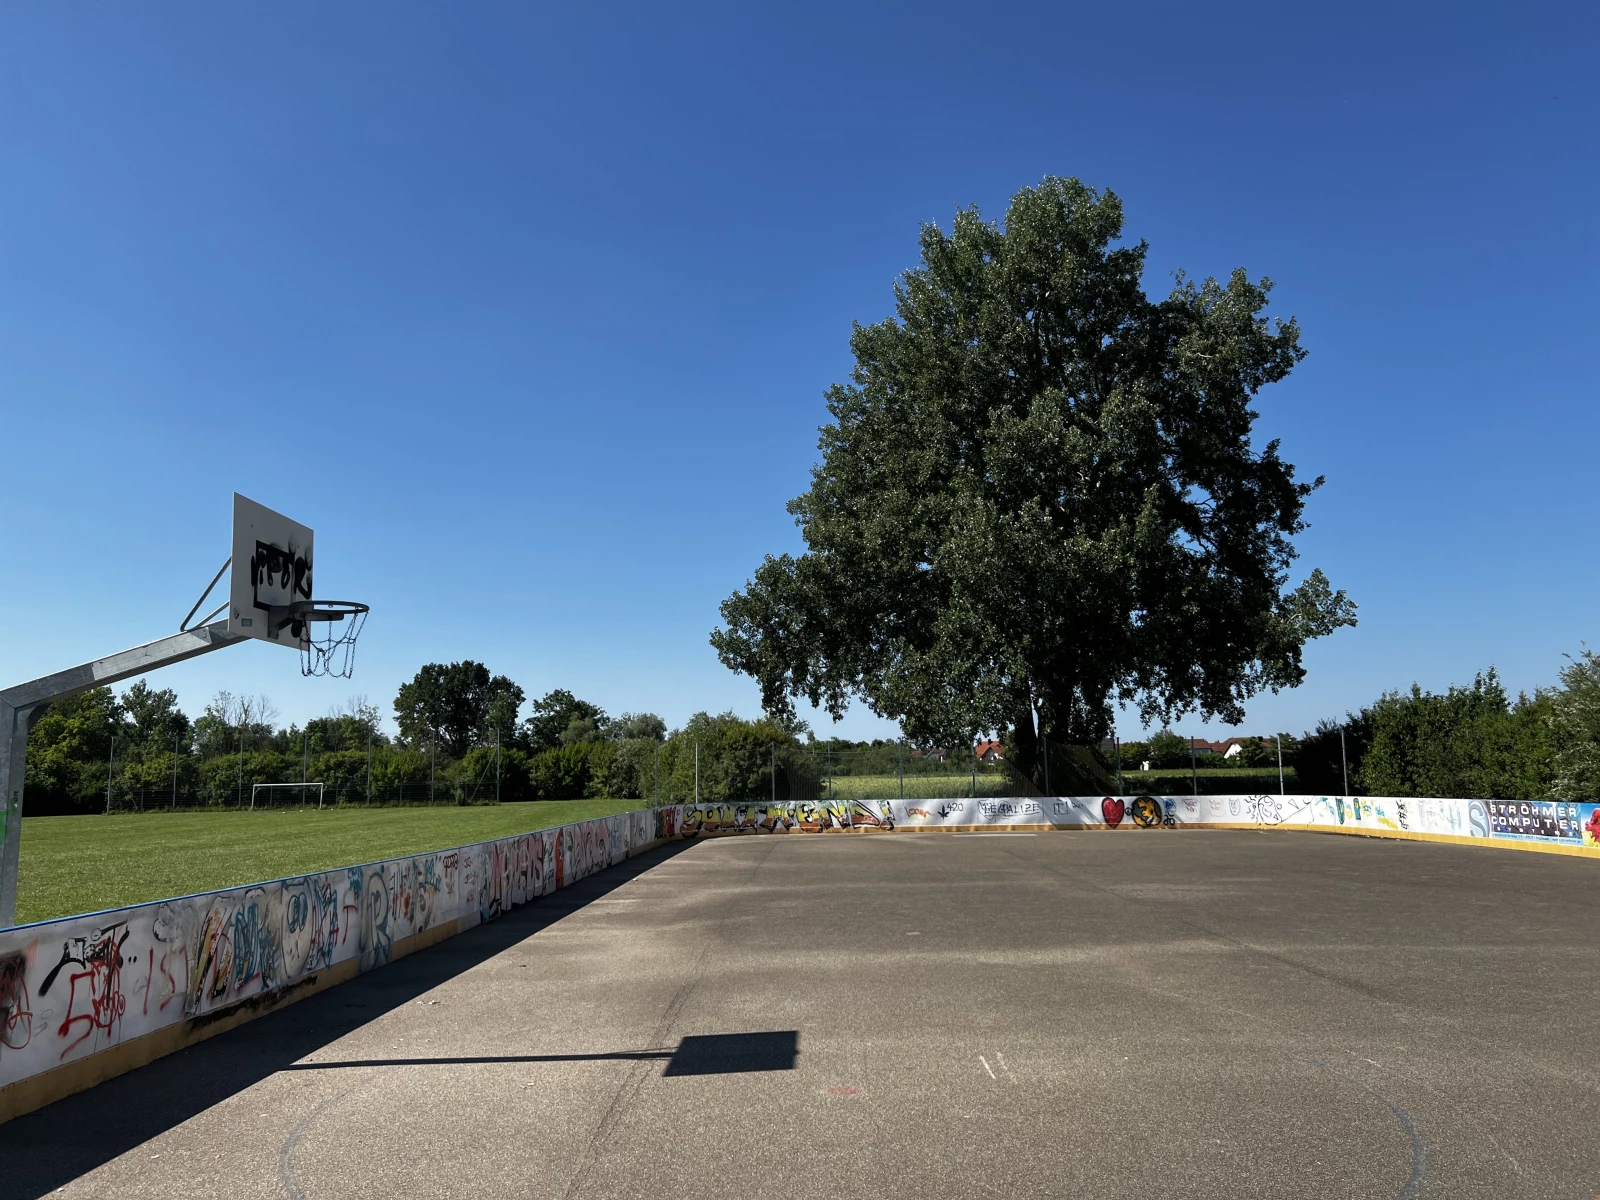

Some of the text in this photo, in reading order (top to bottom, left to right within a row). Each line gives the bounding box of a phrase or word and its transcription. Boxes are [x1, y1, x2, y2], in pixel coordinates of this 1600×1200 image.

[946, 802, 964, 812] 420
[1490, 803, 1577, 818] STRÖHMER
[1491, 817, 1579, 831] COMPUTER
